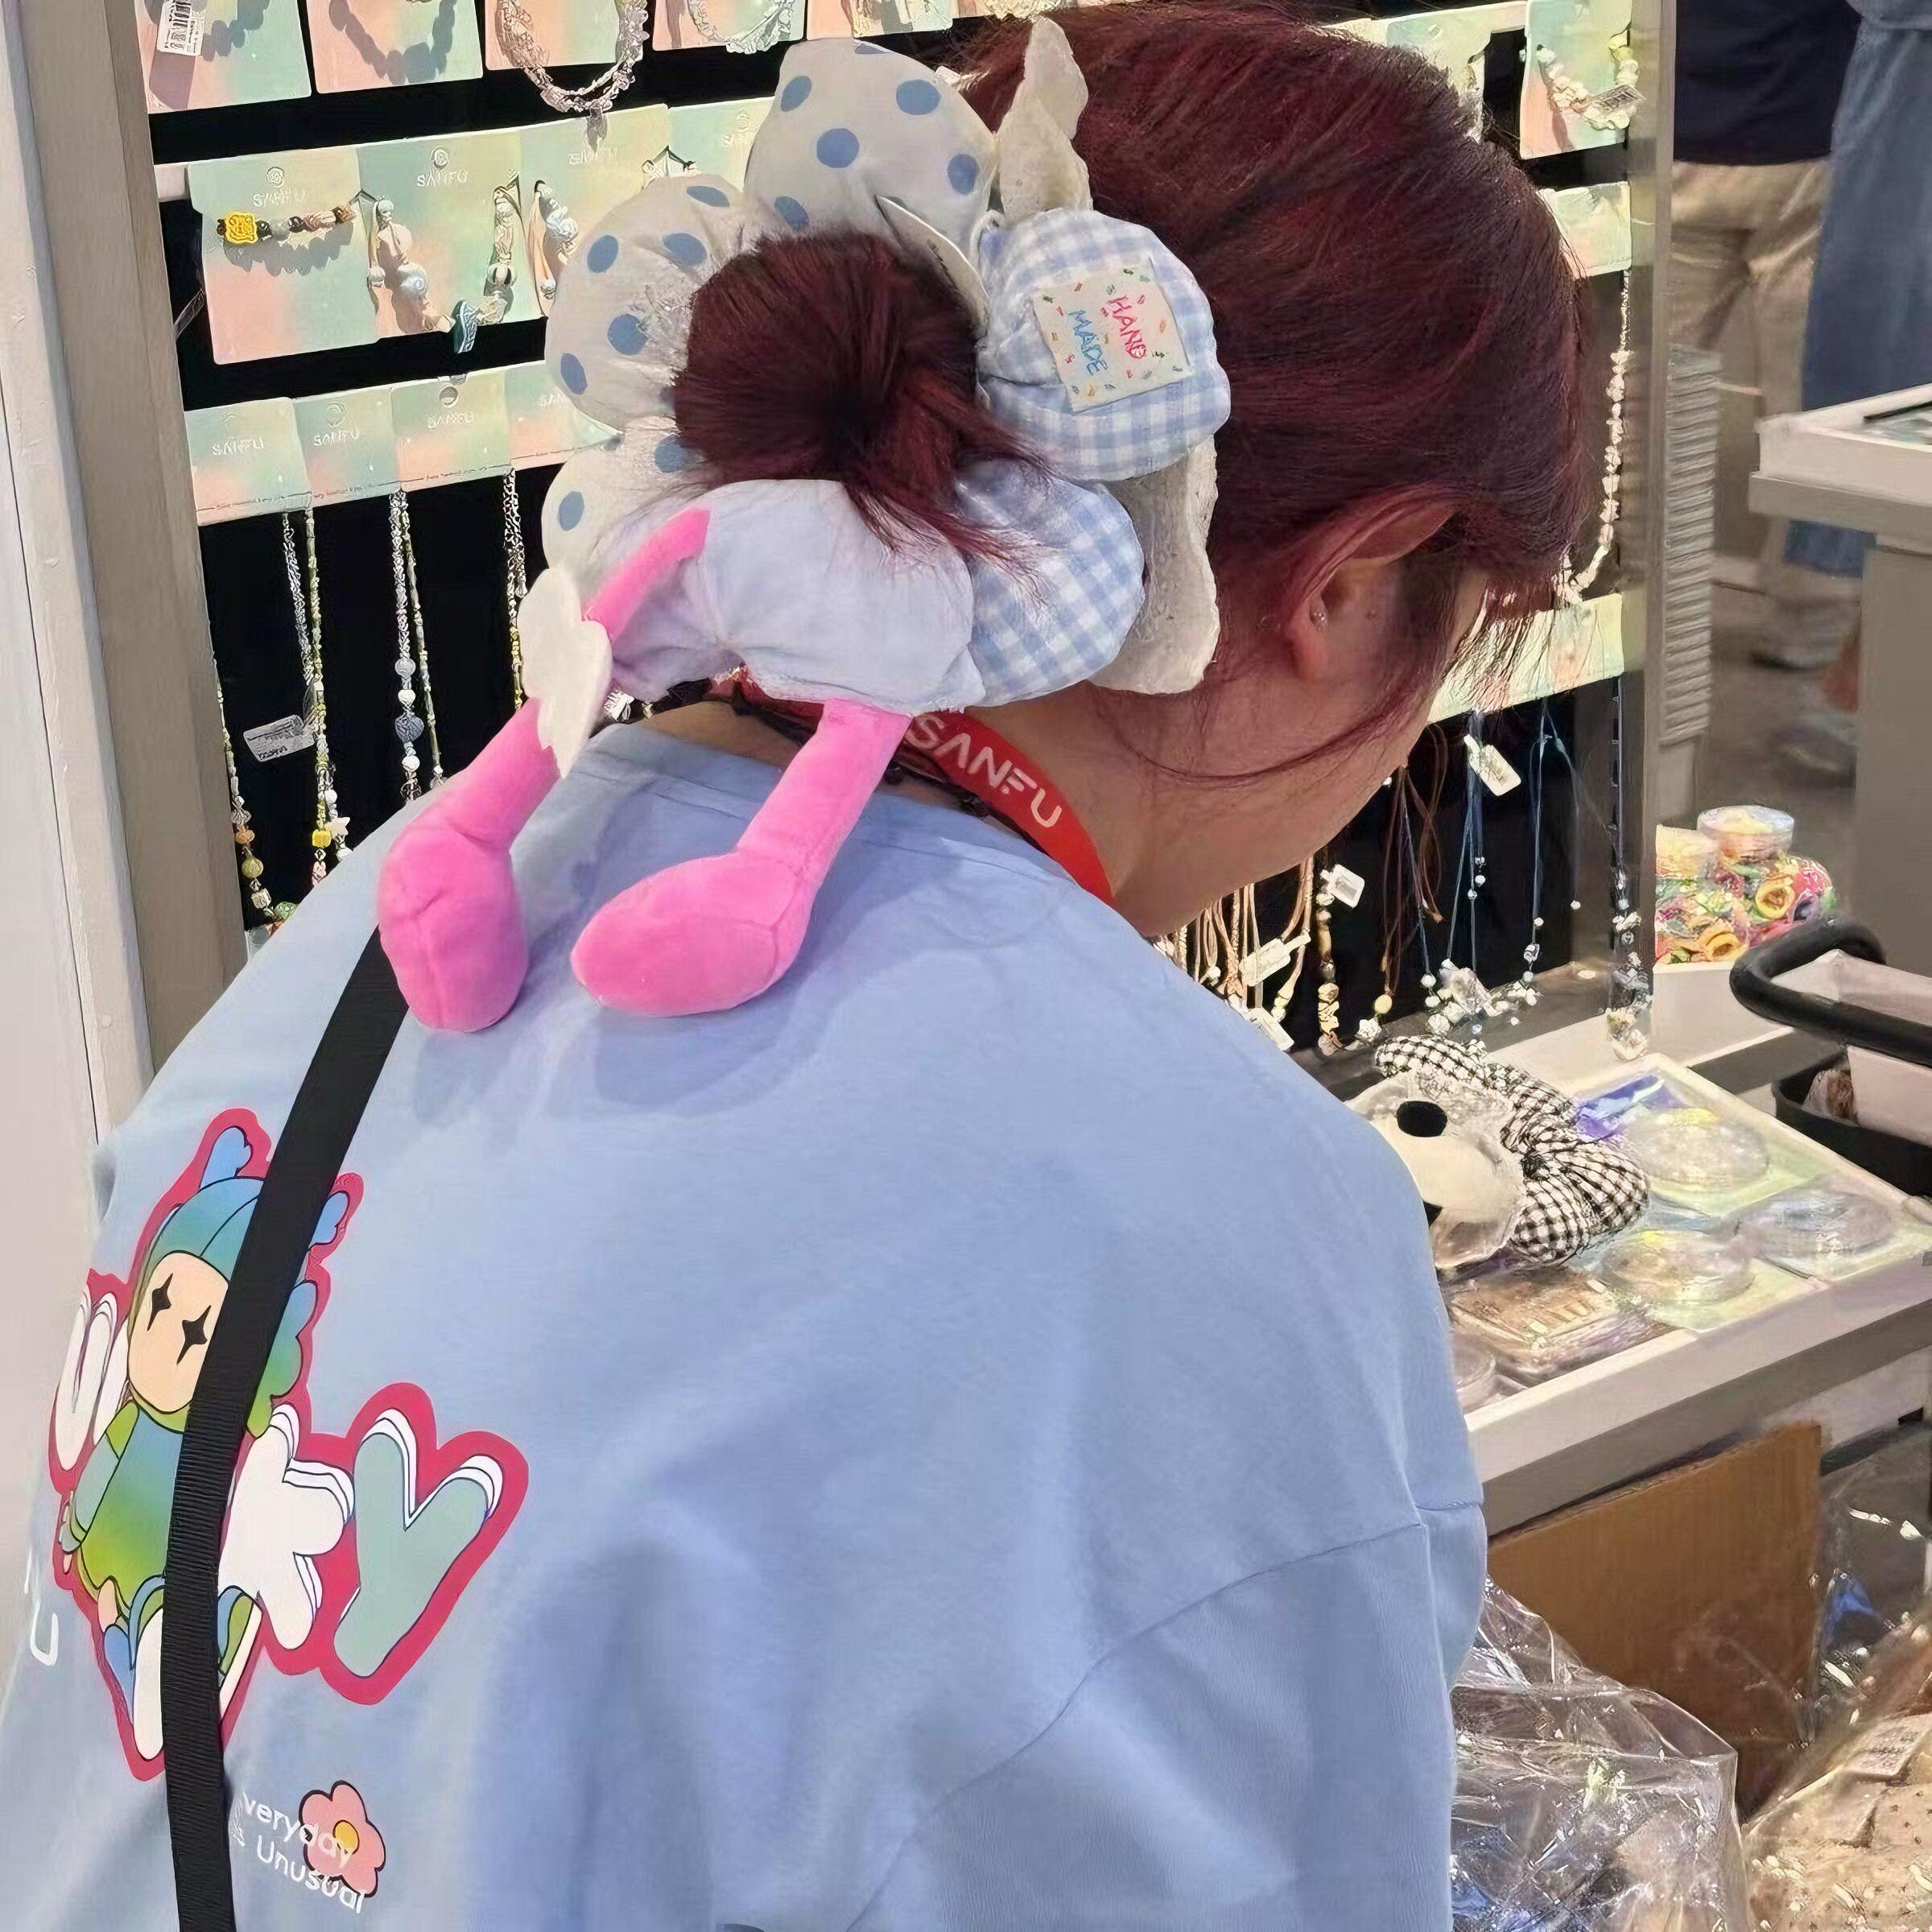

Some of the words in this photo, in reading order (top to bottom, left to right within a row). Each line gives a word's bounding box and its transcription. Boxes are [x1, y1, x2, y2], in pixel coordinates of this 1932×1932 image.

[1067, 309, 1108, 376] MADE
[1106, 295, 1146, 359] HAND
[905, 714, 1063, 828] SANFU
[242, 1792, 353, 1868] veryday
[256, 1835, 367, 1913] Unusual
